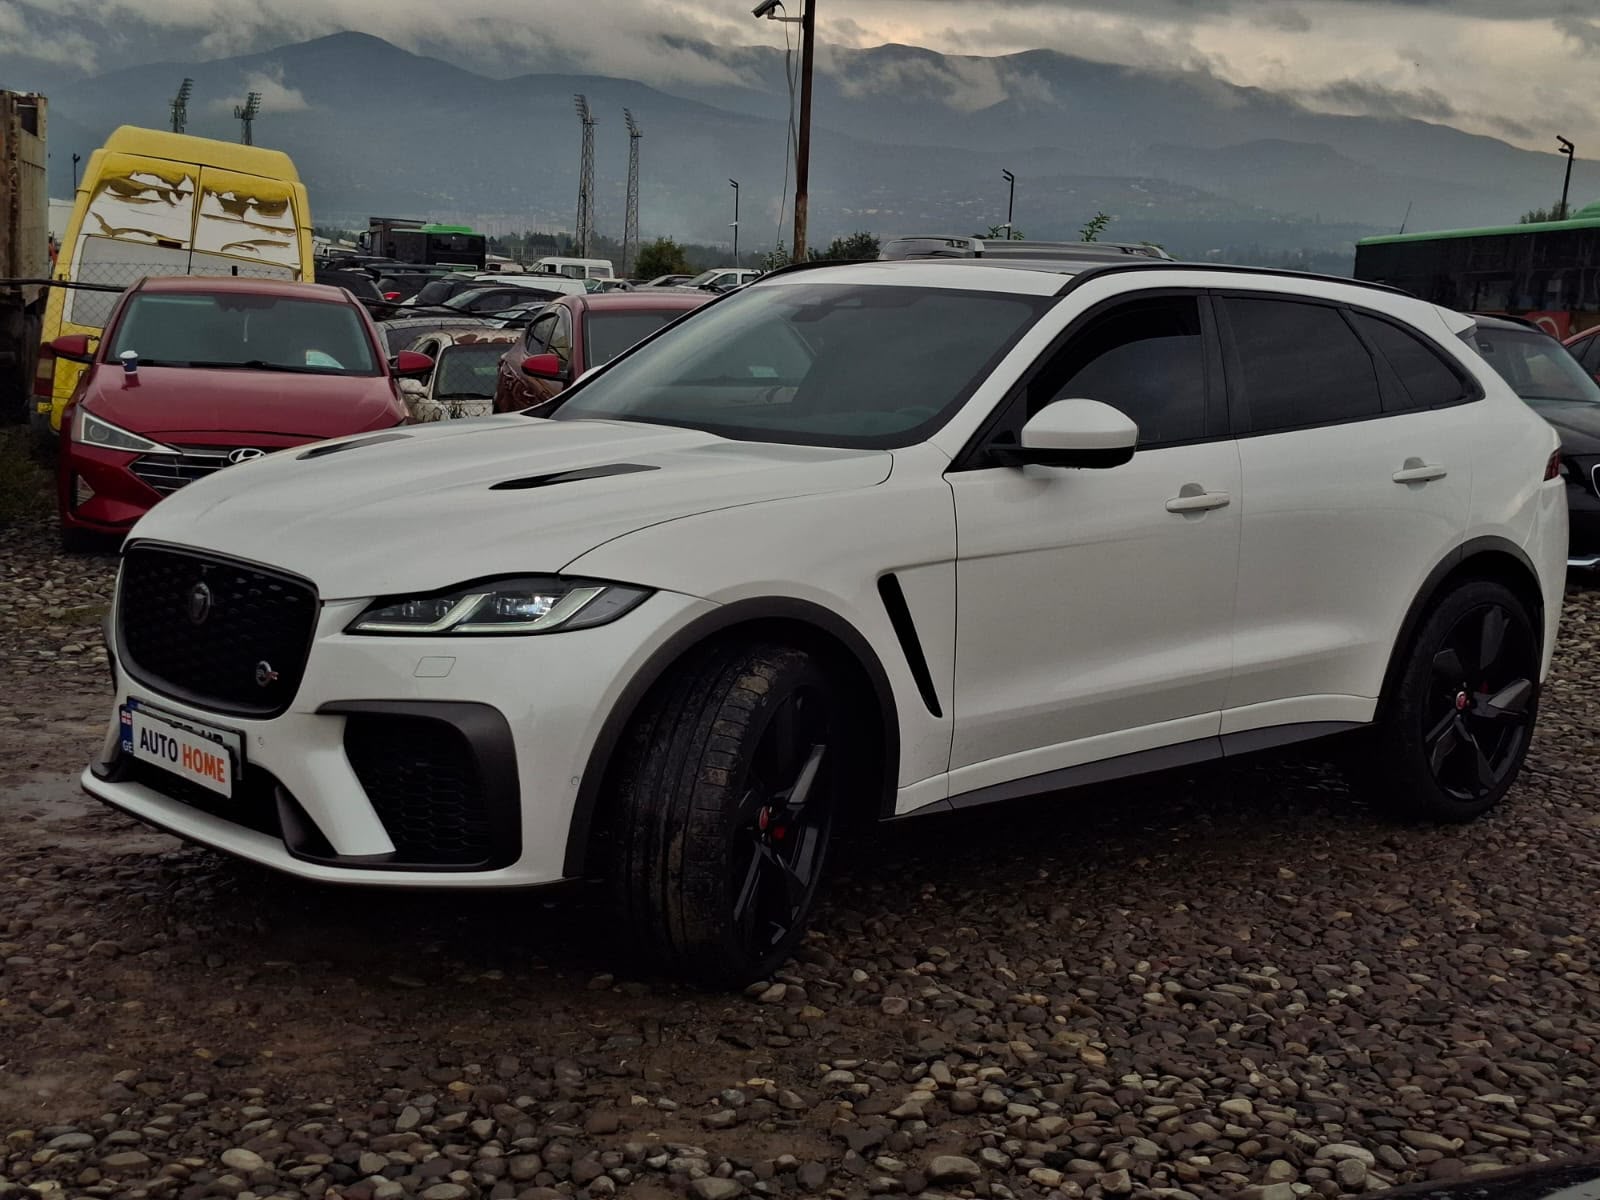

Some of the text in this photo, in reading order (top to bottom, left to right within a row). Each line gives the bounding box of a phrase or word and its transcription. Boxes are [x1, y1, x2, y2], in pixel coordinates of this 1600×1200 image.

[122, 740, 134, 753] GE
[140, 727, 178, 762] AUTO
[182, 743, 225, 783] HOME
